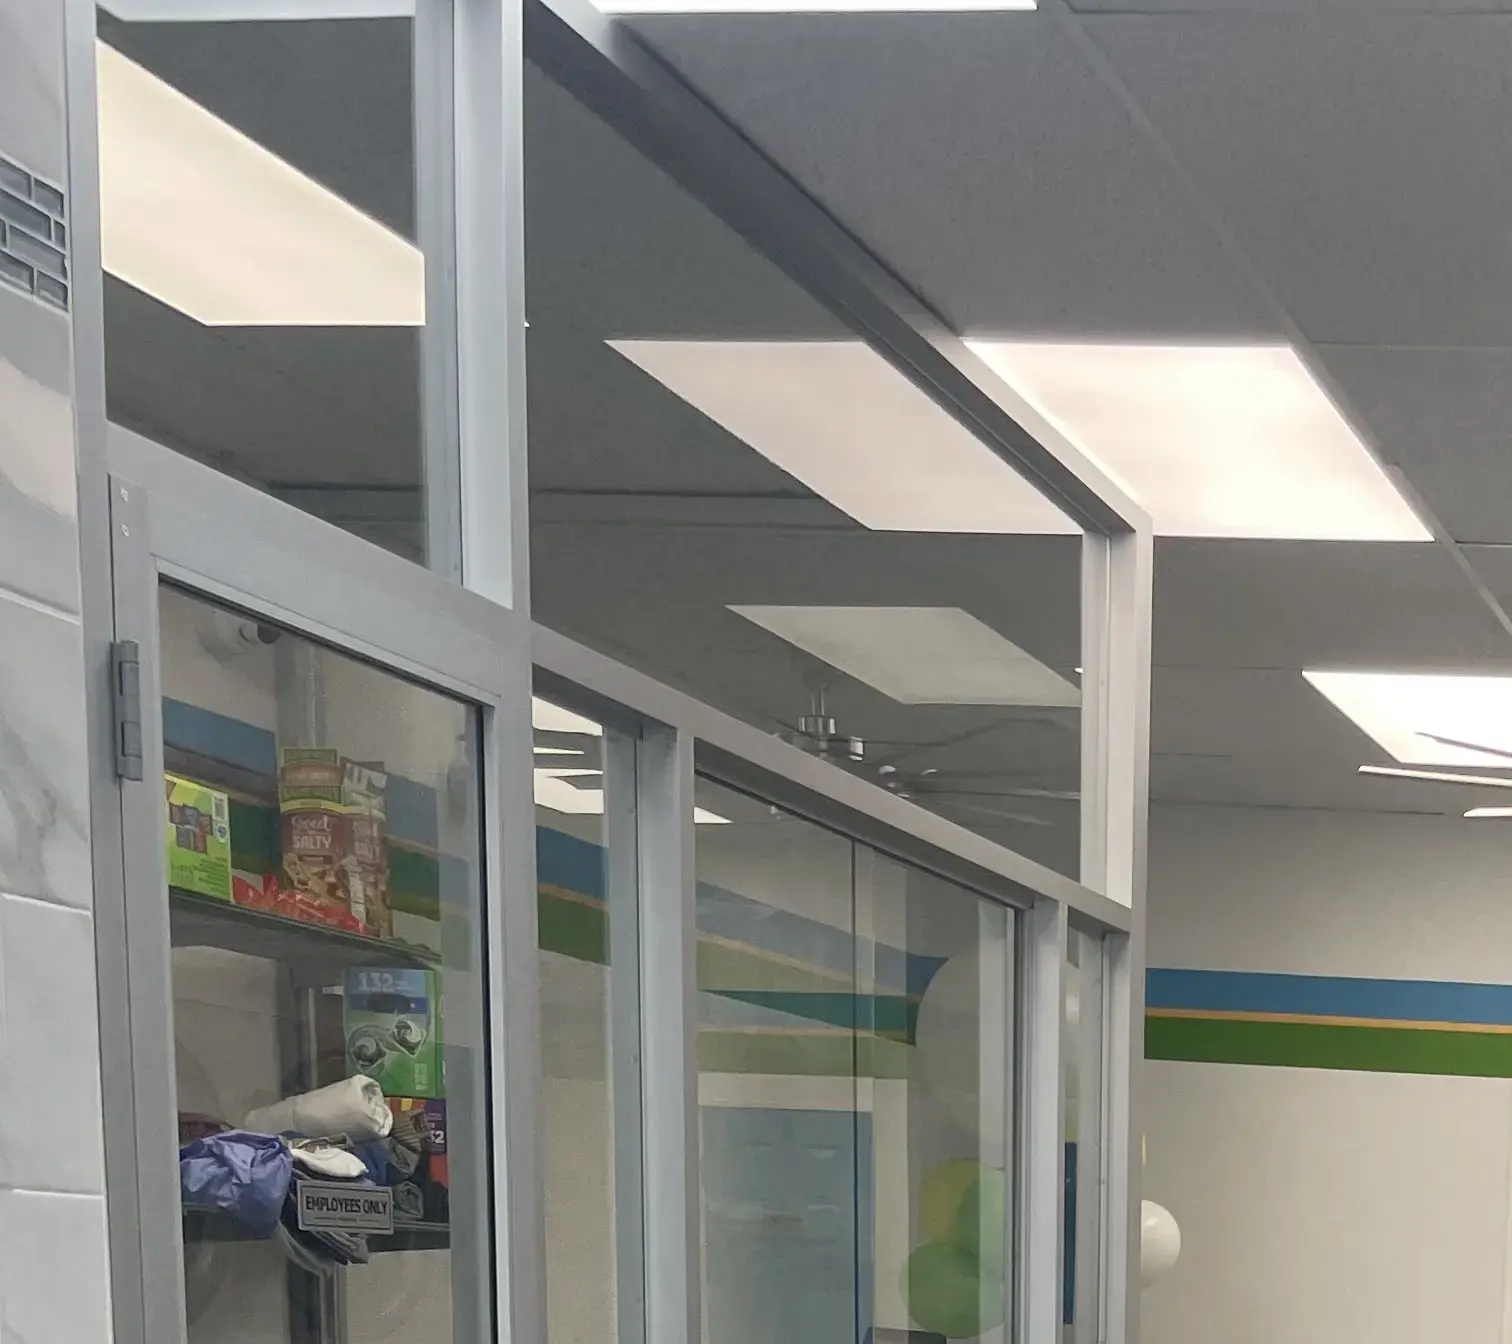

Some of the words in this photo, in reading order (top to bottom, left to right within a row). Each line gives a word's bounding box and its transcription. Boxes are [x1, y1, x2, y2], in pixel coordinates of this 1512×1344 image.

[293, 835, 331, 850] SALTY
[358, 972, 394, 992] 132
[305, 1195, 361, 1213] EMPLOYEES
[362, 1200, 388, 1215] ONLY
